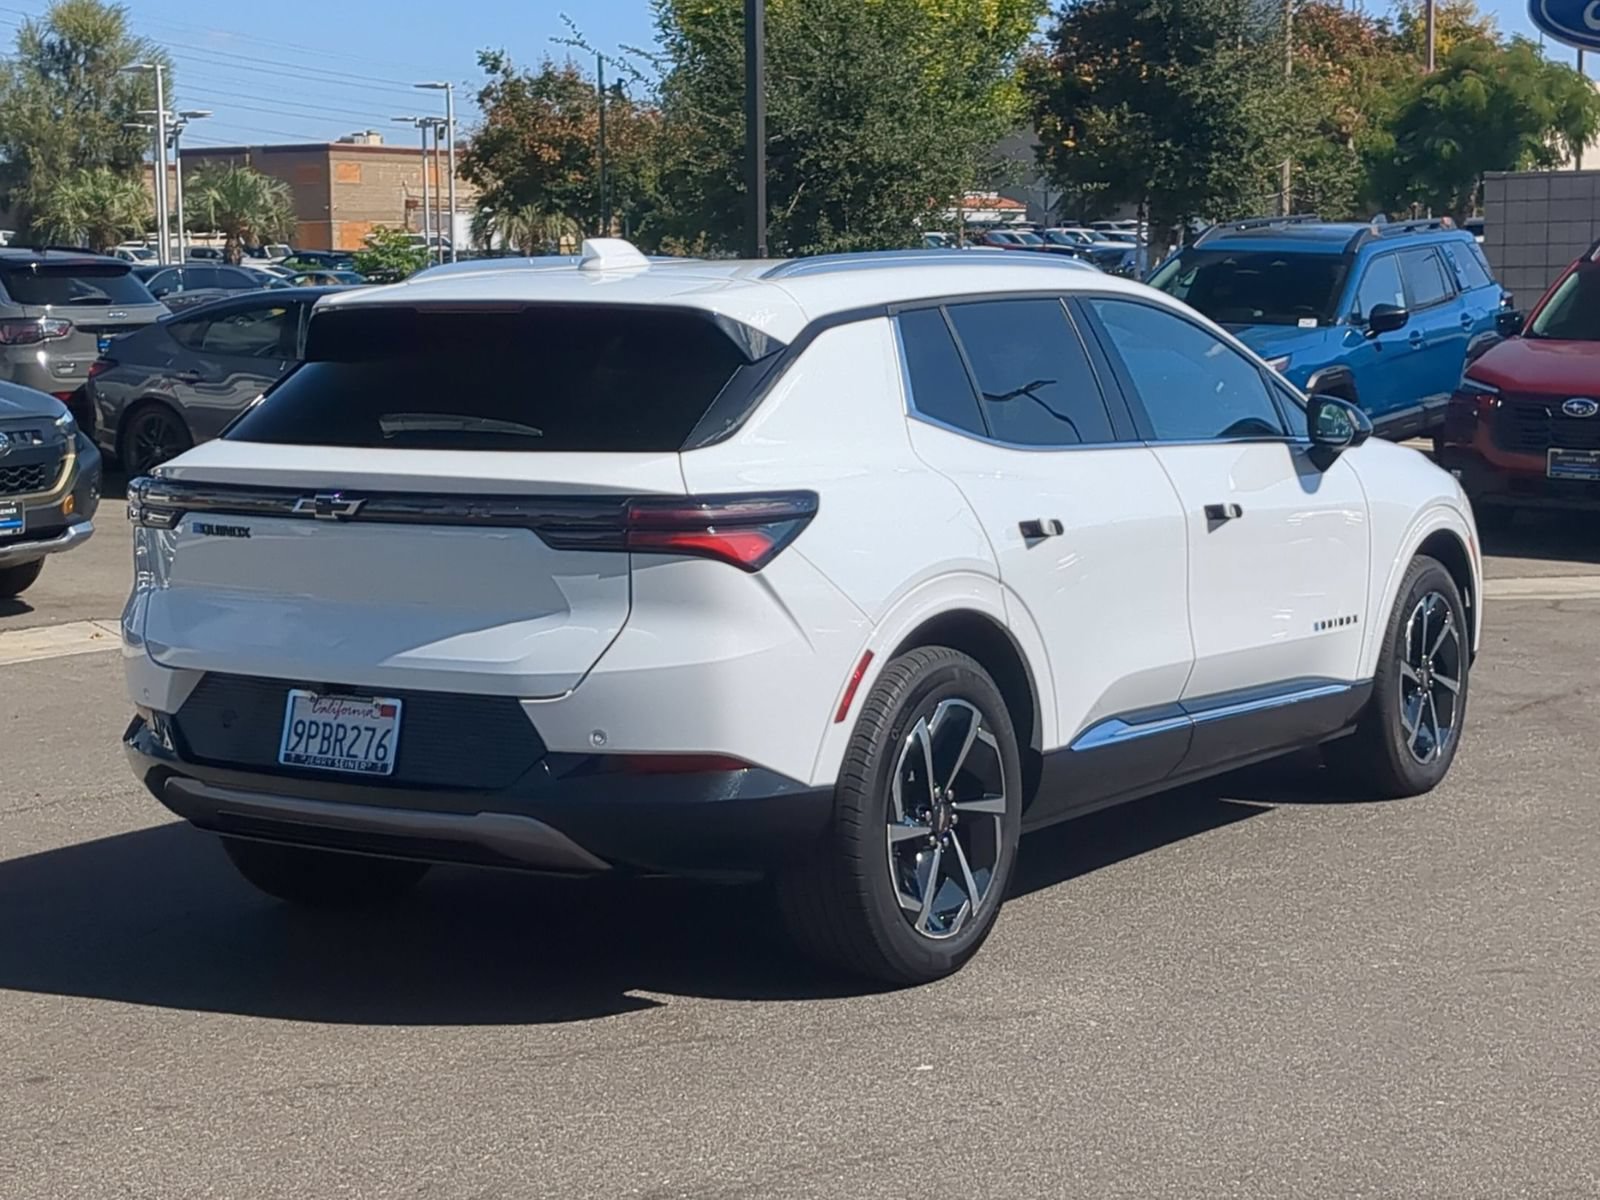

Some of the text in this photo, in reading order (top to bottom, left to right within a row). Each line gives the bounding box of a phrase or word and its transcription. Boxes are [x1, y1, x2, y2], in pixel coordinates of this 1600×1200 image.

[311, 696, 379, 720] California
[289, 719, 393, 762] 9PBR276
[304, 756, 367, 770] JERRY SEINER
